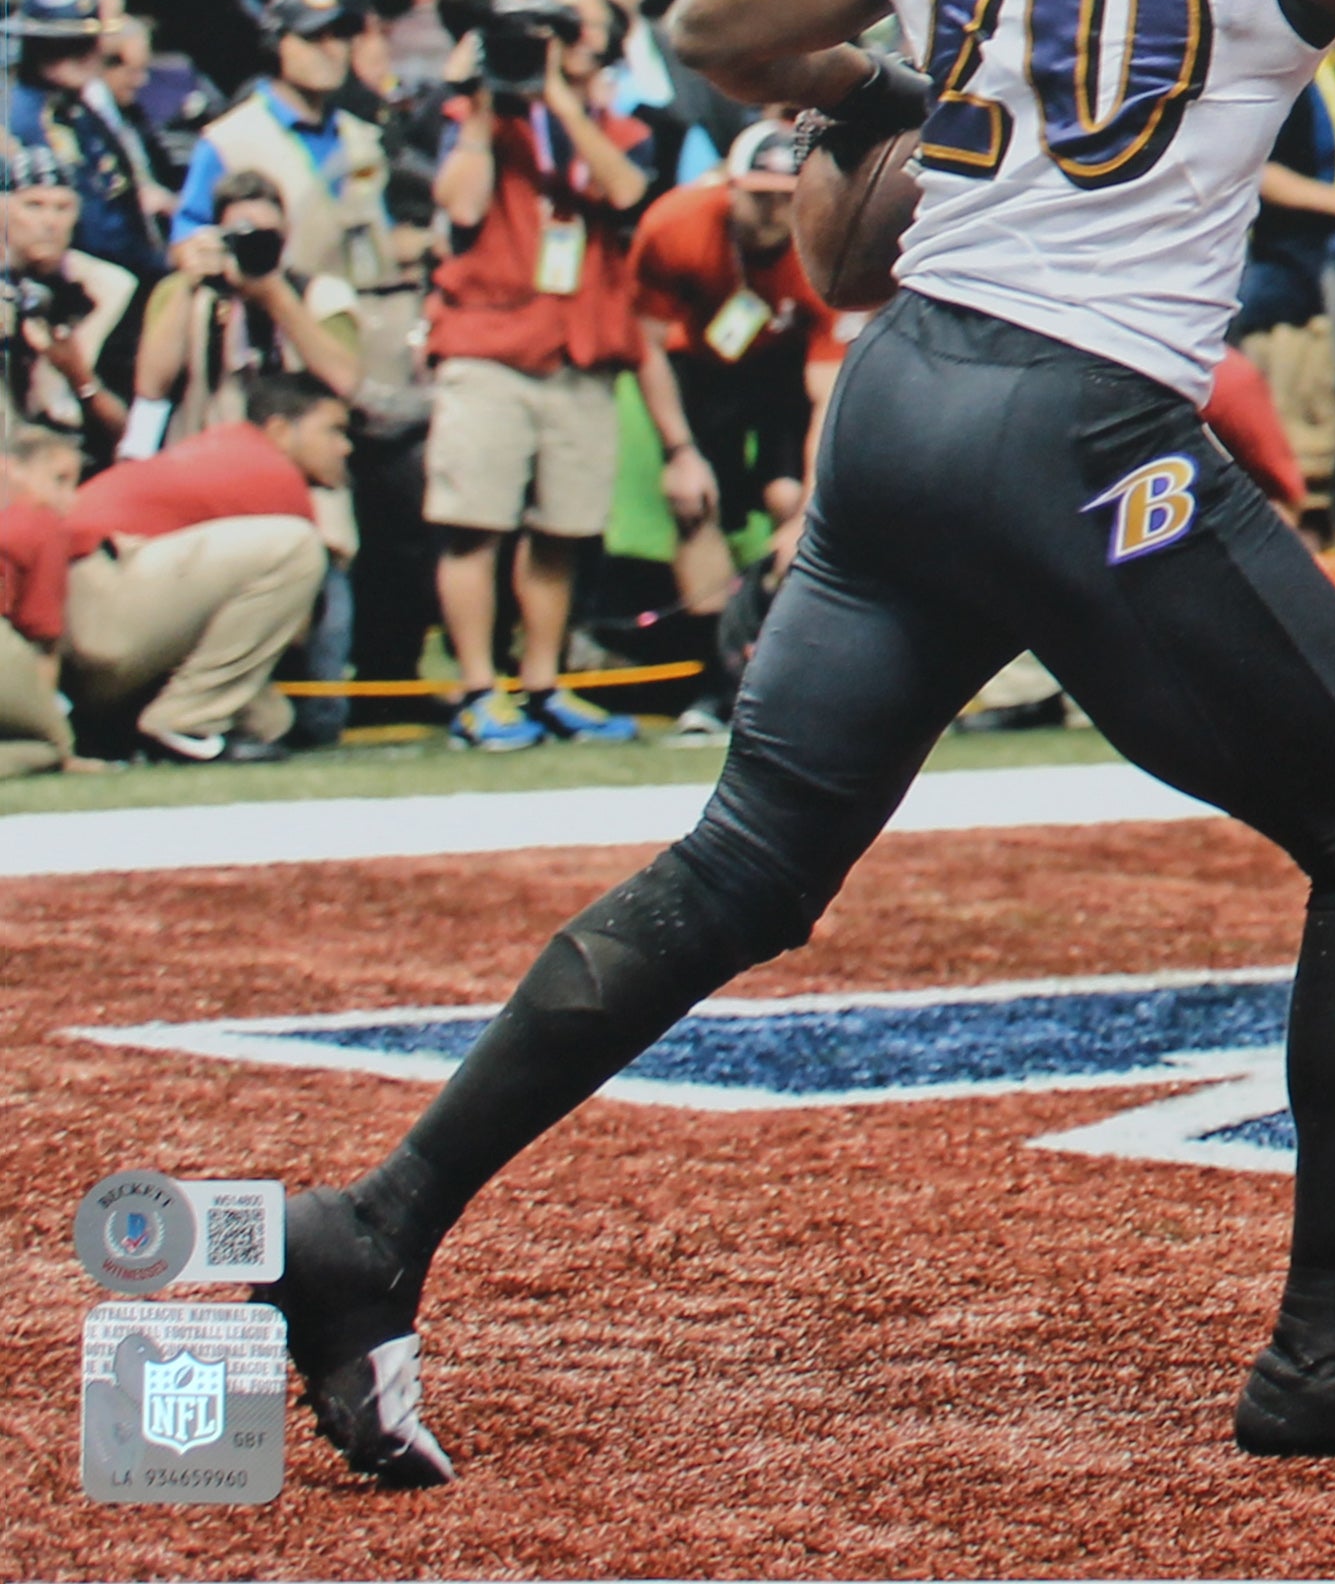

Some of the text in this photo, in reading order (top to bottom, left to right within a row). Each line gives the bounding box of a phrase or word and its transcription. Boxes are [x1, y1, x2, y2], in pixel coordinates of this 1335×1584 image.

[1078, 453, 1199, 565] B
[97, 1182, 175, 1209] BECKETT
[151, 1394, 215, 1443] NFL
[111, 1469, 133, 1487] LA
